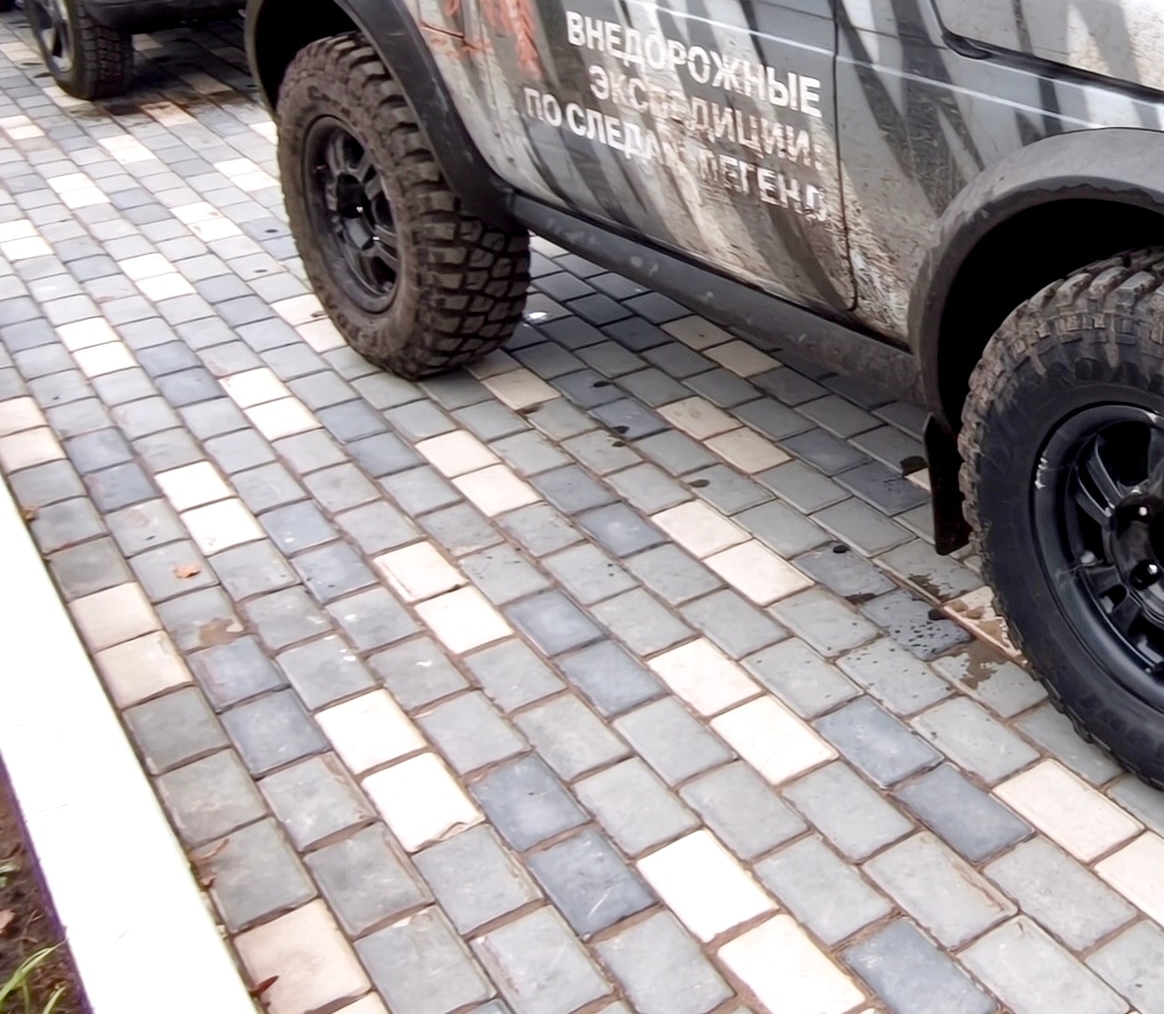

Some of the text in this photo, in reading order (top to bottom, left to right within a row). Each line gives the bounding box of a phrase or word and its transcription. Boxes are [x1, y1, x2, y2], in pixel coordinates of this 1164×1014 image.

[565, 11, 822, 117] ВНЕДОРОЖНЫЕ
[524, 87, 562, 127] ПО
[566, 103, 680, 168] СЛЕДА
